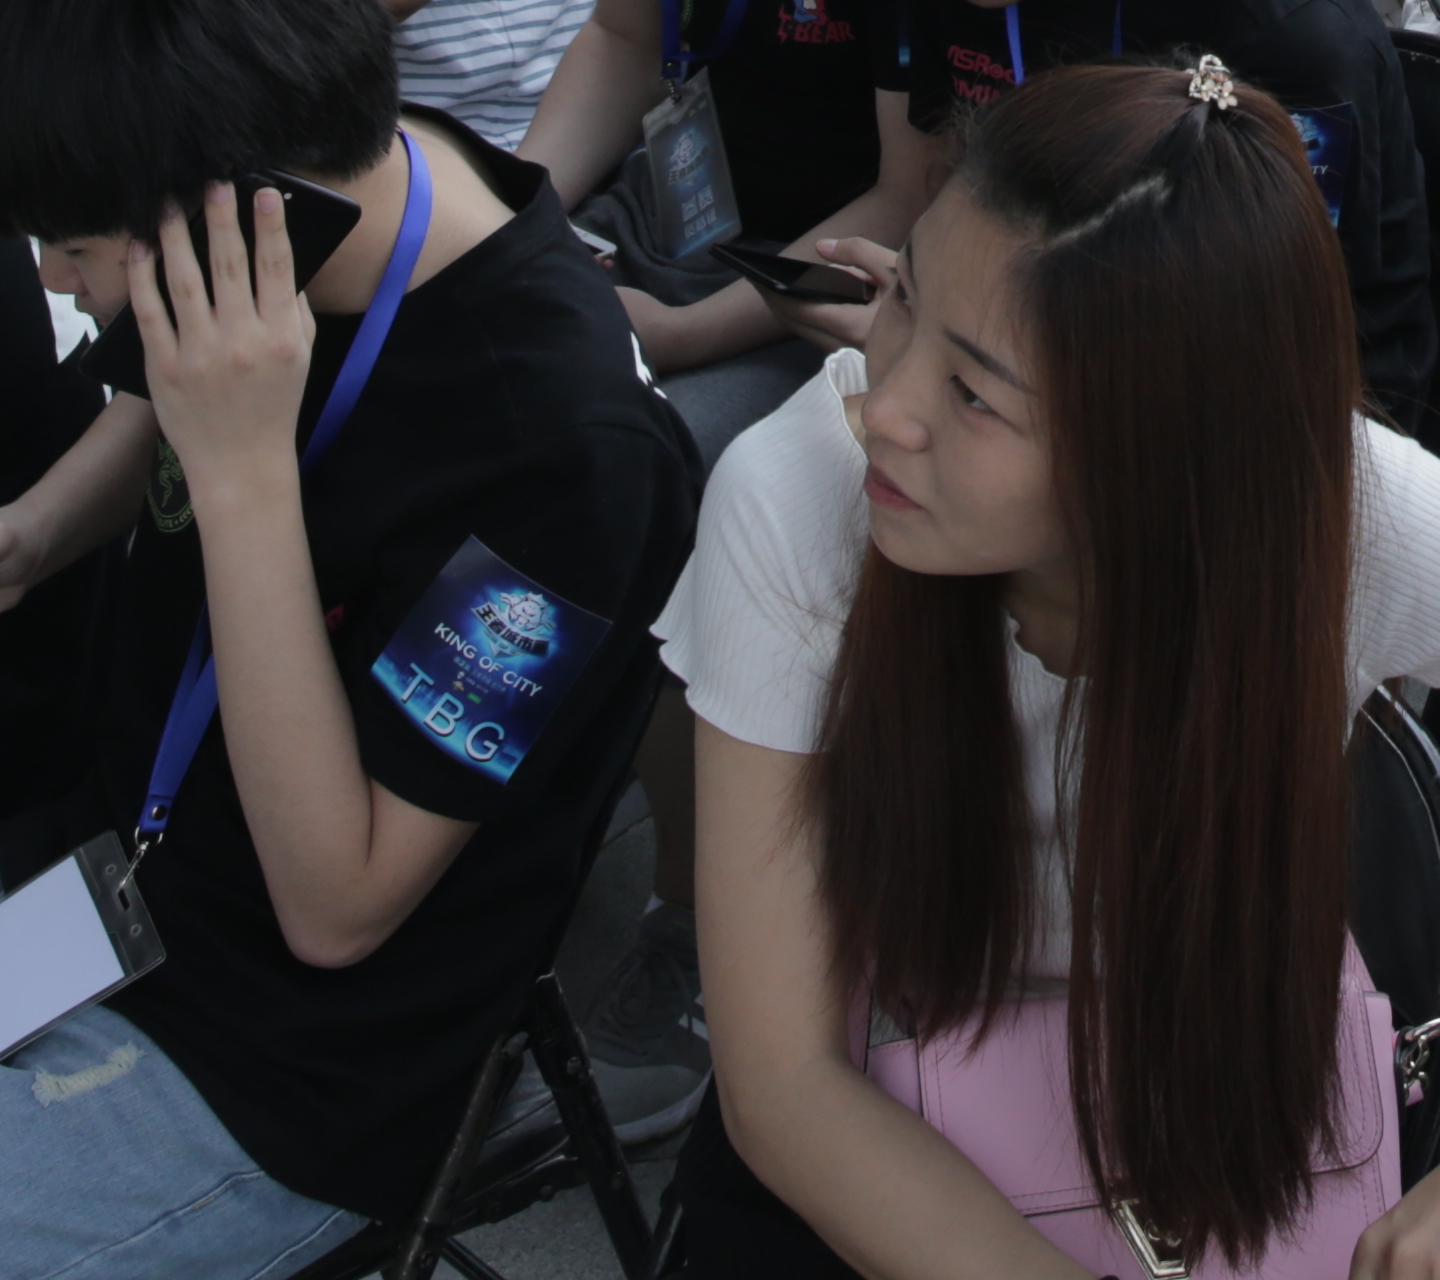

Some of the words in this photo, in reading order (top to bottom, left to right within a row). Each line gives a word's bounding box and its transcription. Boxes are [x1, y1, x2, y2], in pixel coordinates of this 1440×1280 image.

[433, 621, 477, 661] KING
[478, 649, 501, 674] OF
[501, 663, 544, 698] CITY
